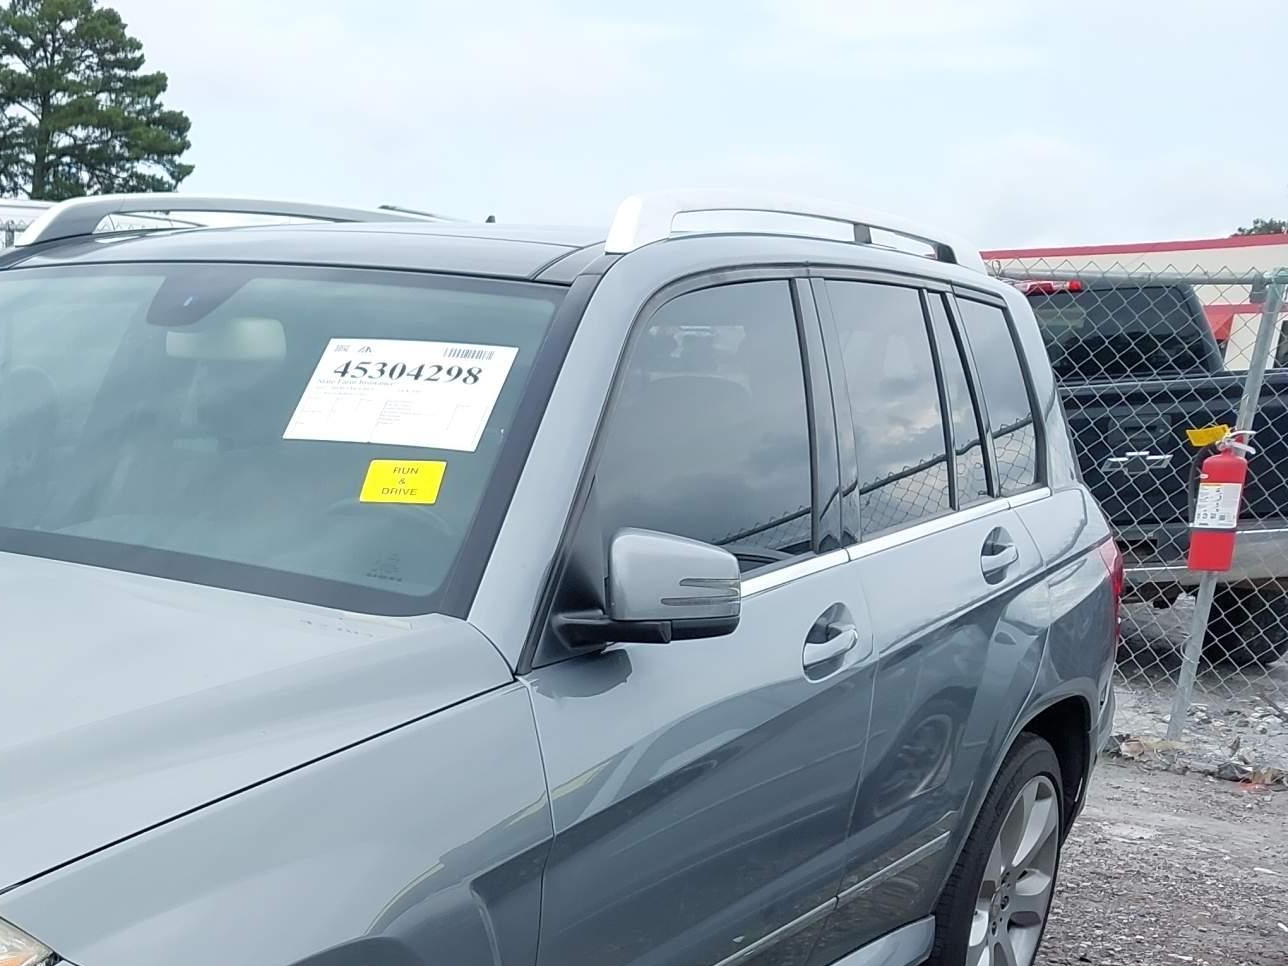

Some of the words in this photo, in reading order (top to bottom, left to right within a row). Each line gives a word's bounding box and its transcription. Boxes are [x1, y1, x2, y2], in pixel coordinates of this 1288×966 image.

[333, 359, 483, 386] 45304298
[393, 466, 419, 475] RUN
[398, 477, 406, 485] &
[381, 487, 418, 496] DRIVE
